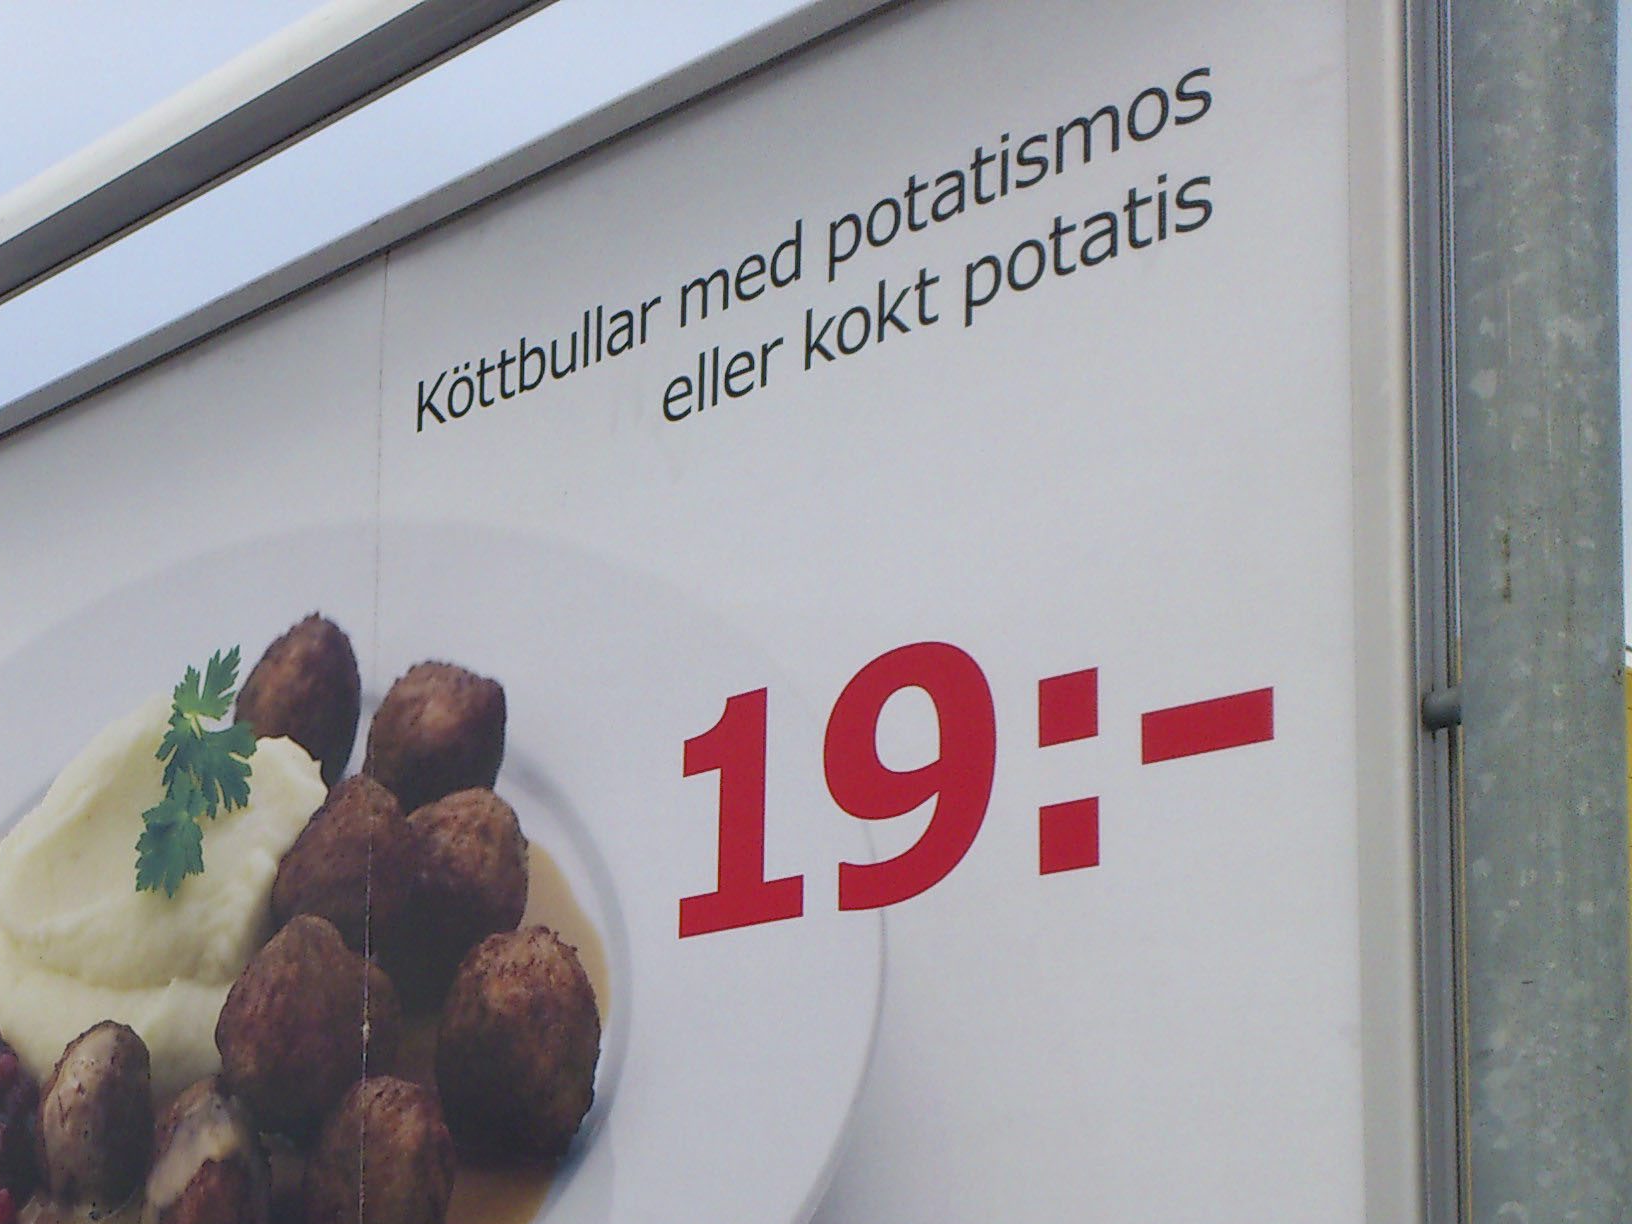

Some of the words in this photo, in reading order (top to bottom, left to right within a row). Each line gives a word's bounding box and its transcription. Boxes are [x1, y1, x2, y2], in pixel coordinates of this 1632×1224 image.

[415, 295, 662, 432] Köttbullar
[679, 219, 803, 328] med
[827, 66, 1213, 283] potatismos
[661, 338, 784, 423] eller
[803, 268, 940, 372] kokt
[963, 173, 1214, 328] potatis
[679, 641, 1274, 938] 19:-
